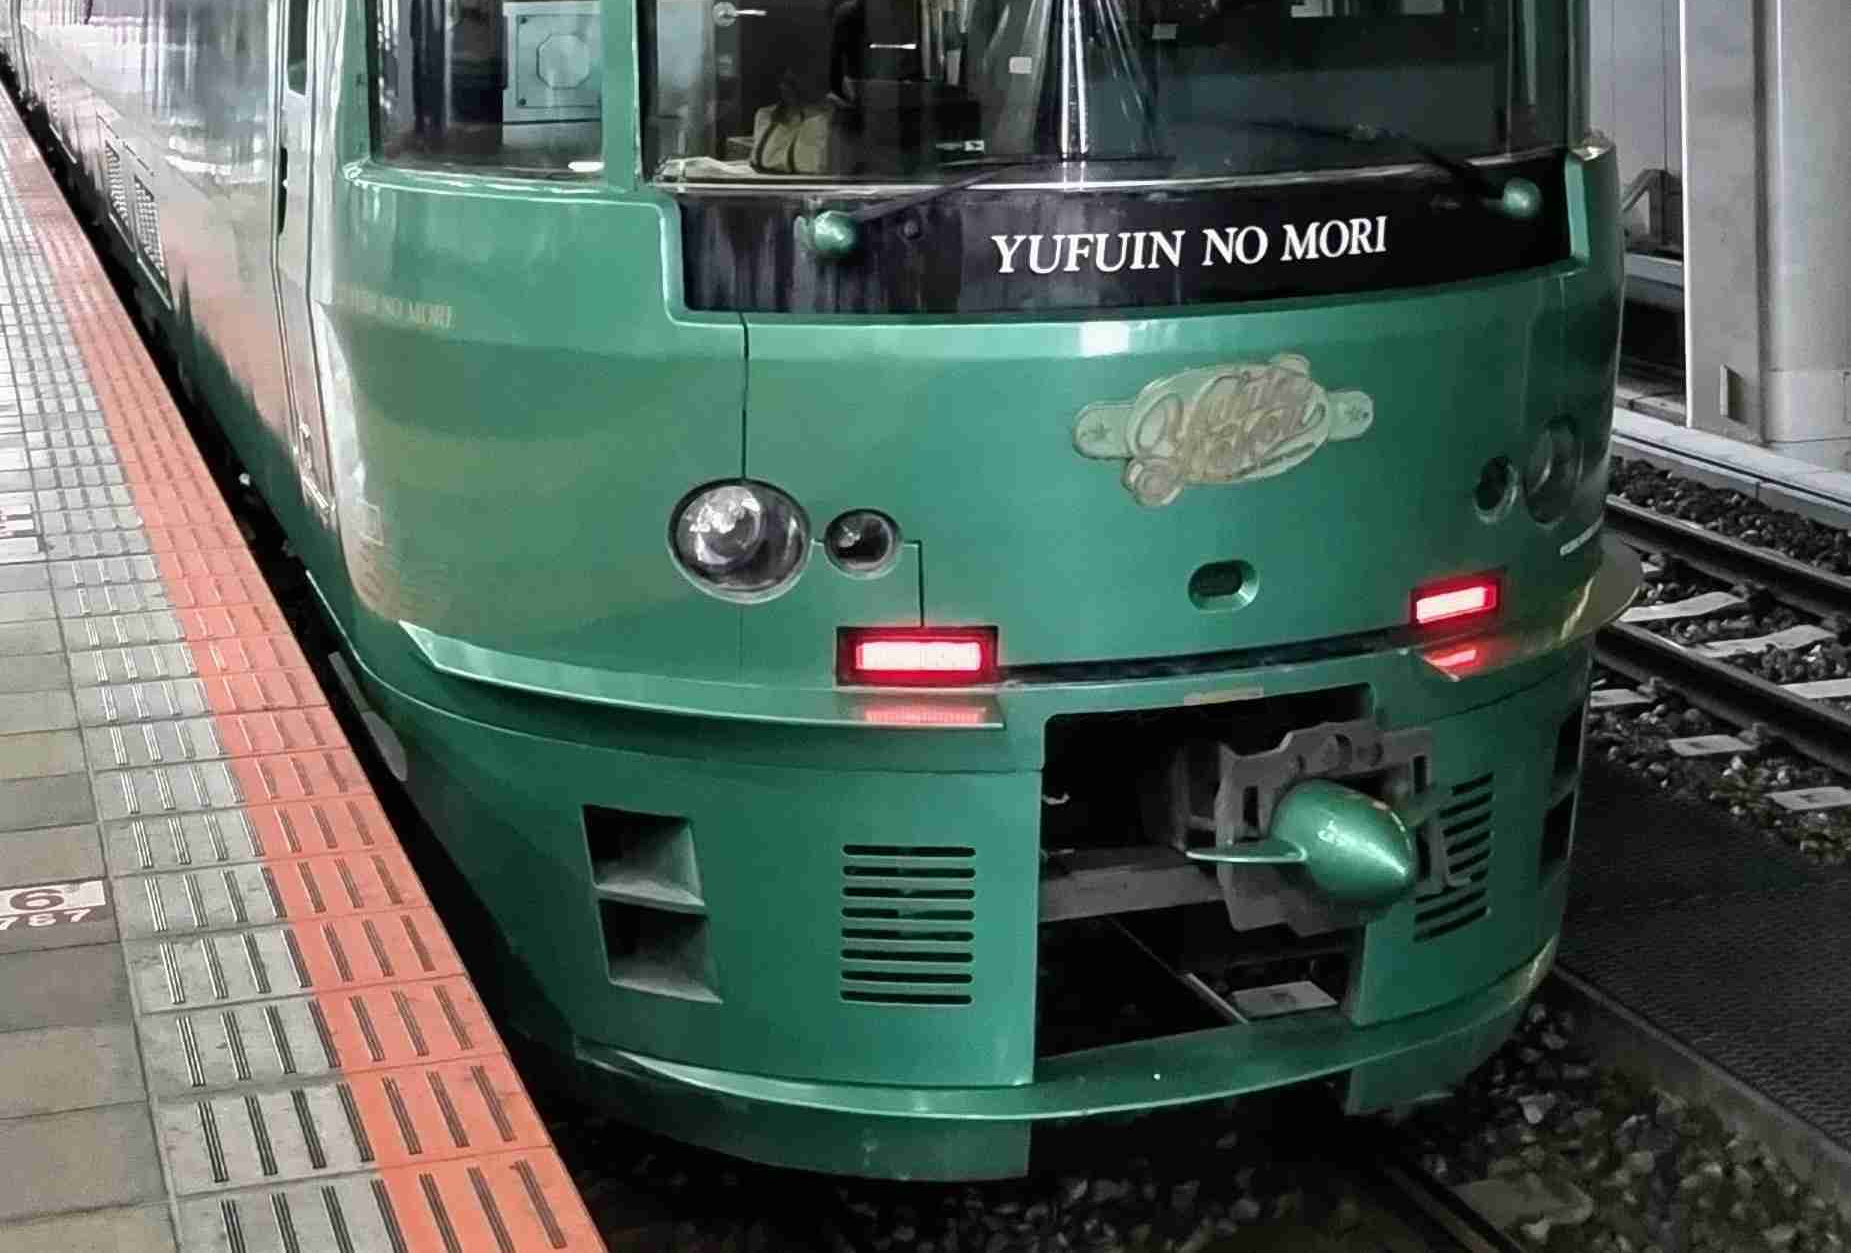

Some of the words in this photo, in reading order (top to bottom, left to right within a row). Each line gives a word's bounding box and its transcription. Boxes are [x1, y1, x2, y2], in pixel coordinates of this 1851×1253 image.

[991, 229, 1186, 275] YUFUIN
[1202, 225, 1269, 267] NO
[1280, 215, 1388, 262] MORI
[9, 889, 65, 911] 6
